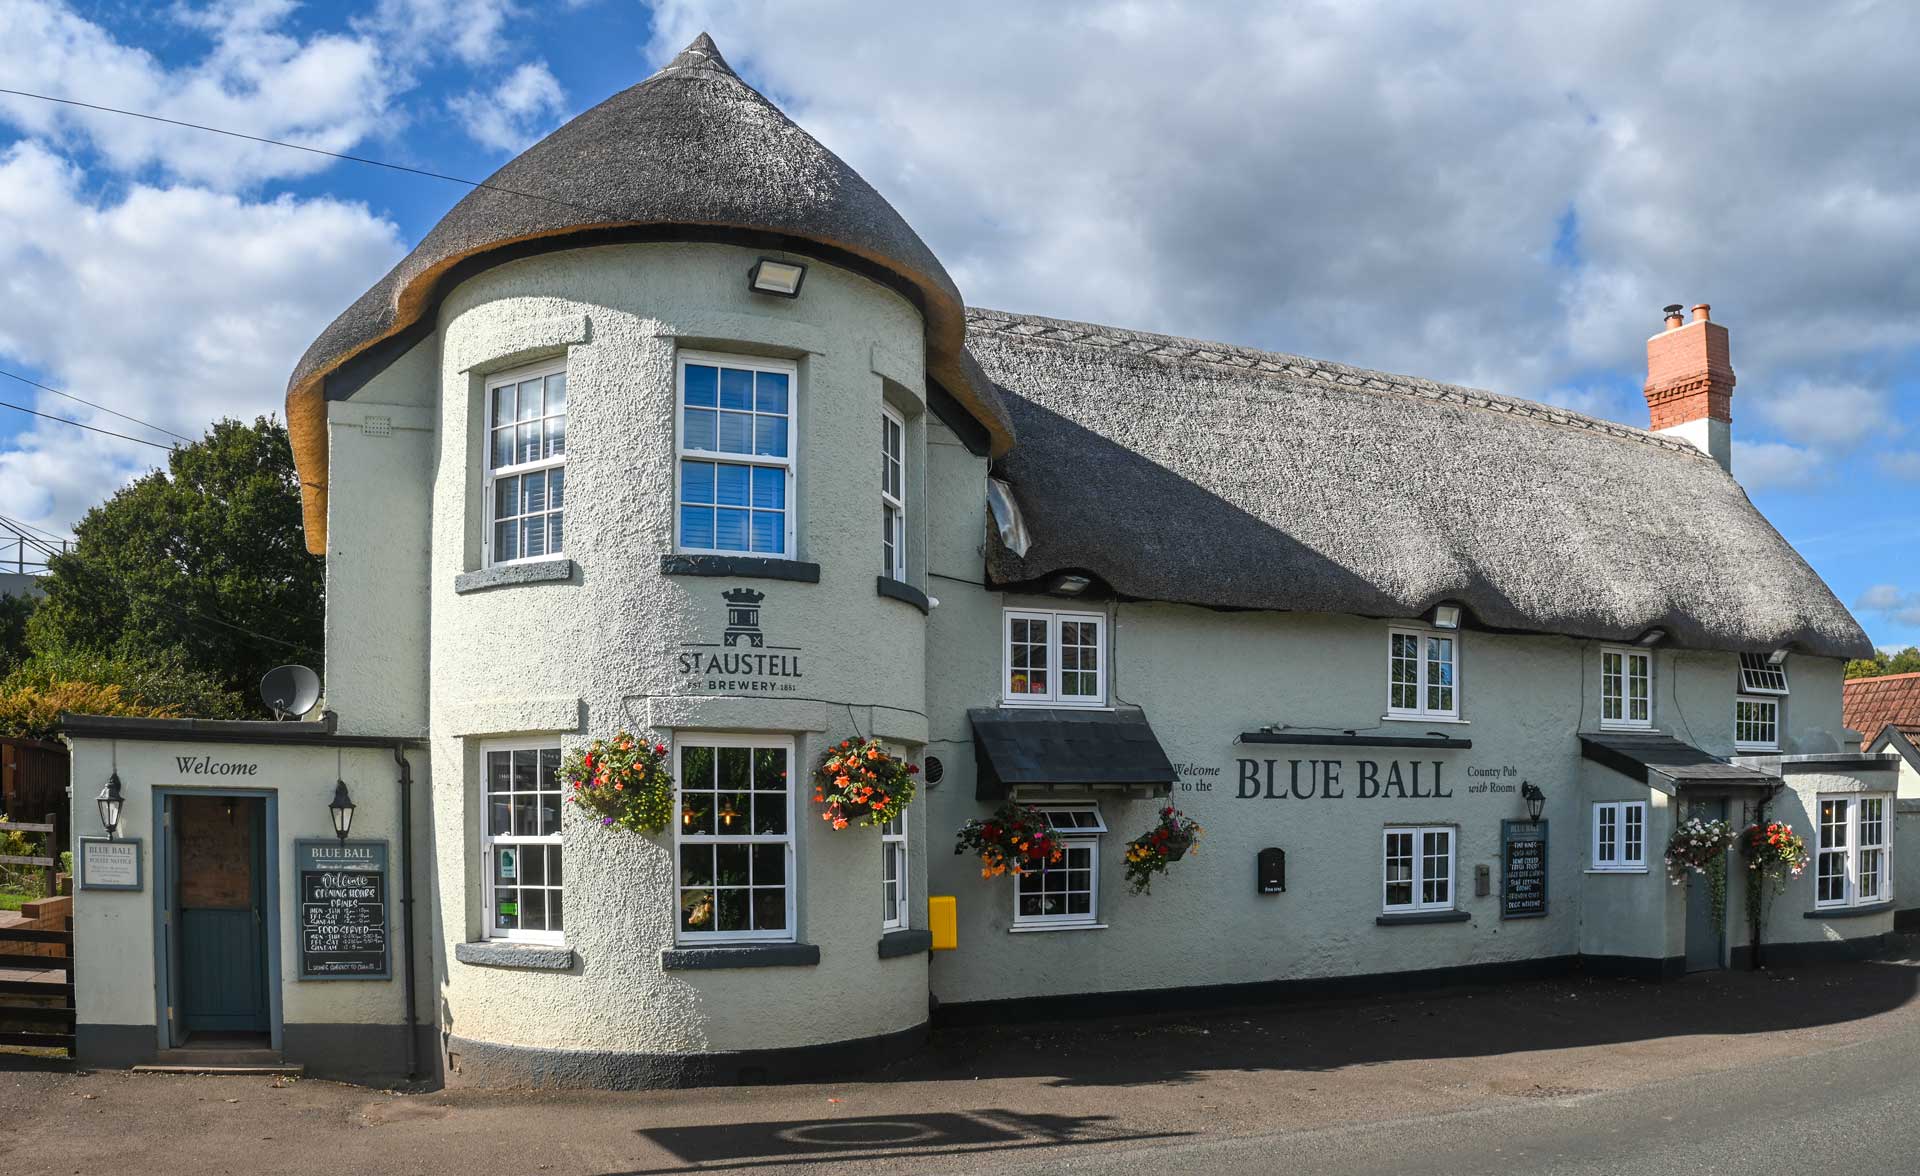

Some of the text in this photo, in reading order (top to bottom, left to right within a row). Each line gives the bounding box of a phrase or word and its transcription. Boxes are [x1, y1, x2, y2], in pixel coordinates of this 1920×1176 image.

[706, 654, 803, 677] AUSTELL
[708, 681, 777, 691] BREWERY
[176, 756, 258, 776] Welcome
[1174, 763, 1220, 777] Welcome
[1467, 765, 1517, 780] Country Pub
[1235, 758, 1454, 800] BLUE BALL
[1181, 780, 1213, 792] to the
[1467, 782, 1516, 793] with Rooms
[112, 847, 132, 855] BALL
[312, 848, 373, 858] BLUE BALL
[315, 888, 375, 899] OPENING HOURS
[331, 899, 358, 907] DRINKS
[318, 925, 369, 934] FOOD SERVED
